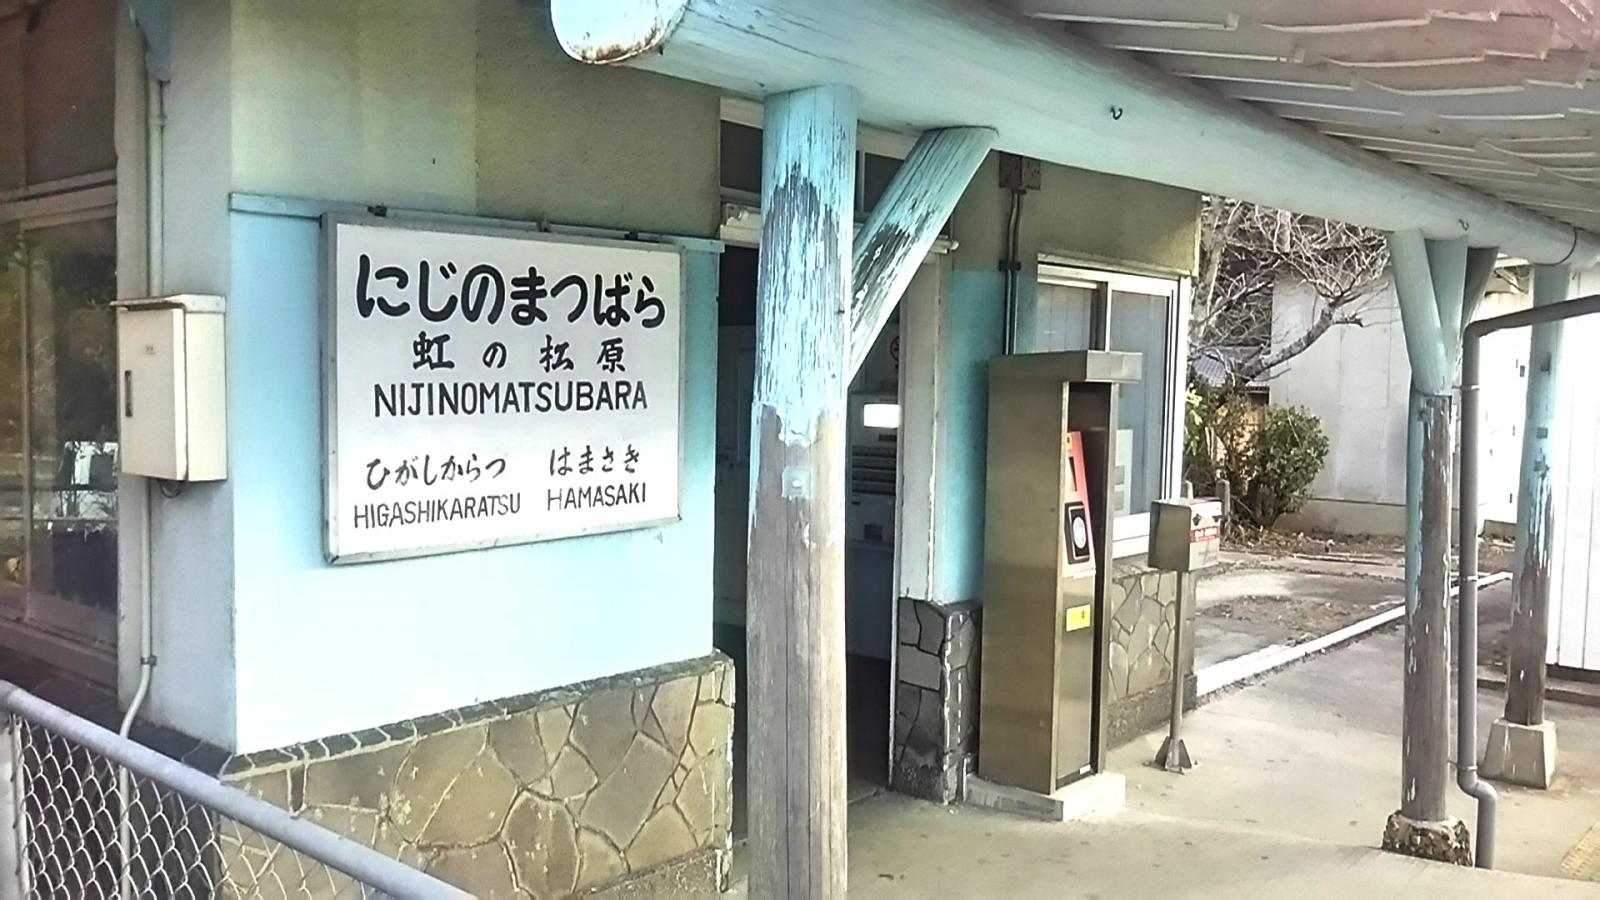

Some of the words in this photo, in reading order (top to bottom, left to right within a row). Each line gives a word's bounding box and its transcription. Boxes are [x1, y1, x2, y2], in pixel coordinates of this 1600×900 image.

[356, 253, 666, 328] にじのまつばら
[412, 331, 626, 374] 虹の松原
[373, 380, 648, 418] NIJINOMATSUBARA
[365, 453, 507, 491] ひがしからつ
[549, 443, 641, 477] はまさき
[353, 491, 522, 529] HIGASHIKARATSU
[546, 482, 648, 512] HAMASAKI
